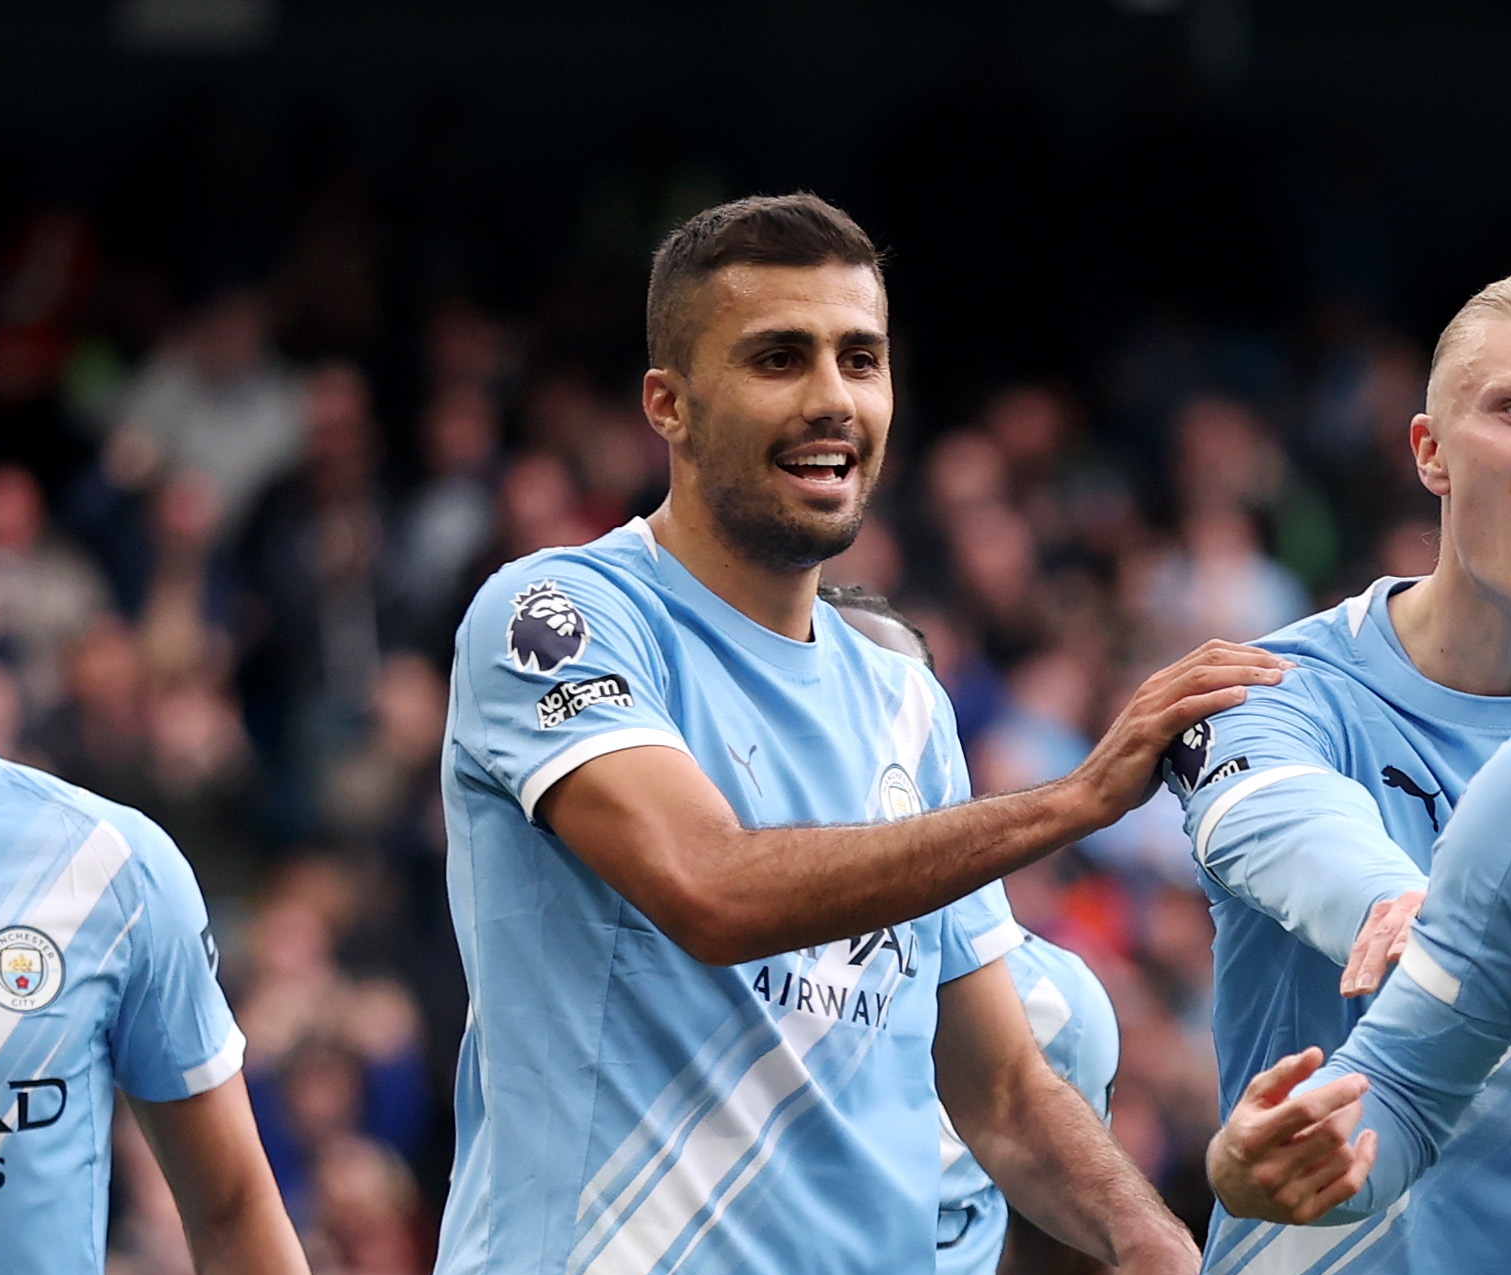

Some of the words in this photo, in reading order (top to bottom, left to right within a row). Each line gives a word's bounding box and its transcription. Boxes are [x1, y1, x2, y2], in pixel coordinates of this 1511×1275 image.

[536, 693, 563, 719] No
[11, 998, 35, 1007] CITY
[753, 965, 893, 1030] AIRWAY
